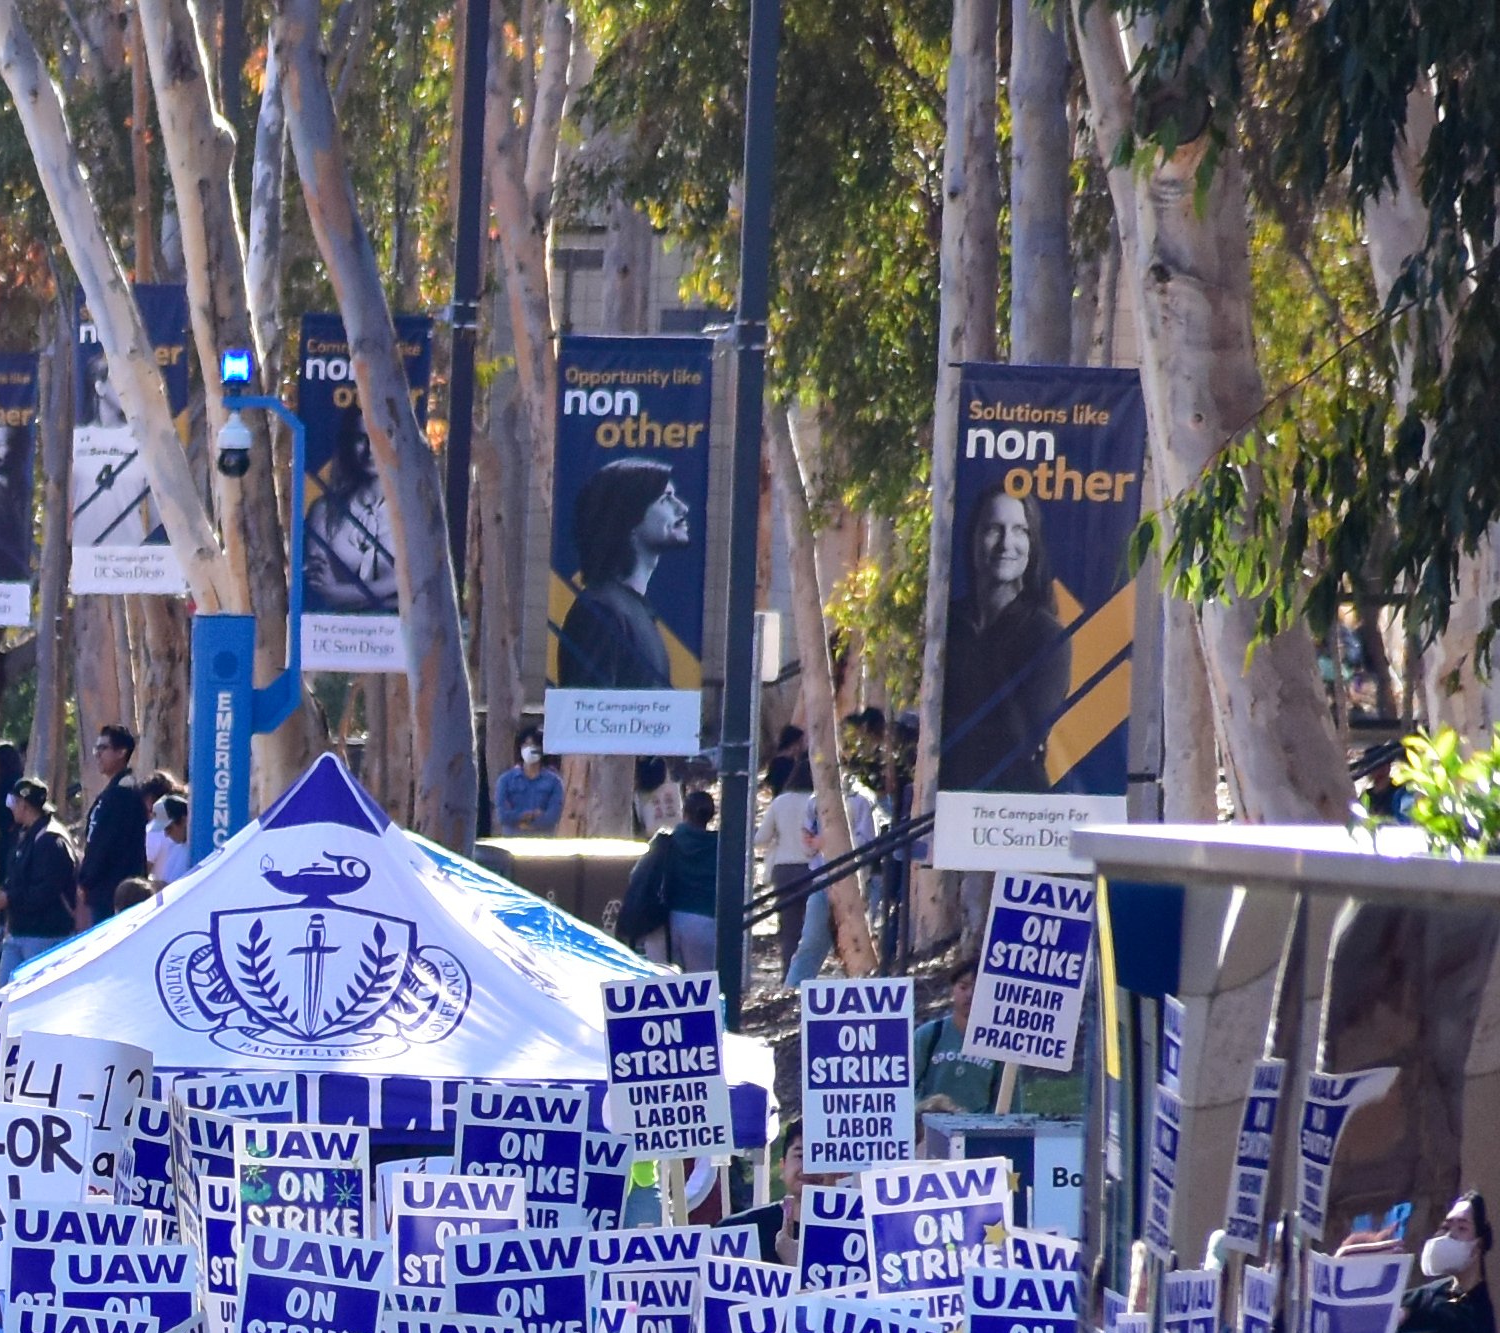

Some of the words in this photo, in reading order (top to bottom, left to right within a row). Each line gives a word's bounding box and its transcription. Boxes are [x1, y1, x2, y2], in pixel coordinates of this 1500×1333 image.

[565, 367, 668, 388] Opportunity
[672, 368, 701, 385] like
[564, 388, 638, 416] non
[969, 401, 1067, 425] Solutions
[1071, 405, 1110, 425] like
[596, 411, 703, 449] other
[966, 427, 1056, 460] non
[1004, 458, 1136, 501] other
[313, 624, 328, 633] The
[331, 625, 377, 638] Campaign
[313, 639, 332, 654] UC
[333, 640, 357, 655] San
[359, 640, 394, 656] Diego
[575, 701, 594, 711] The
[598, 701, 650, 713] Campaign
[652, 702, 670, 711] For
[575, 718, 597, 733] UC
[600, 718, 627, 733] San
[629, 719, 670, 737] Diego
[212, 691, 233, 846] EMERGENC
[972, 807, 996, 821] The
[1001, 807, 1061, 825] Campaign
[1065, 808, 1089, 821] For
[972, 828, 1002, 848] UC
[1005, 828, 1039, 848] San
[1041, 829, 1070, 848] Die
[1002, 876, 1095, 913] UAW
[1021, 914, 1062, 946] ON
[987, 940, 1082, 980] STRIKE
[170, 954, 196, 1019] NATIONAL
[421, 960, 460, 1040] CONFERENCE
[807, 985, 907, 1015] UAW
[993, 981, 1064, 1011] UNFAIR
[992, 1004, 1055, 1033] LABOR
[238, 1041, 386, 1060] PANHELLENIC
[837, 1023, 876, 1052] ON
[972, 1025, 1067, 1059] PRACTICE
[810, 1054, 906, 1084] STRIKE
[822, 1092, 896, 1114] UNFAIR
[826, 1116, 892, 1138] LABOR
[810, 1140, 909, 1162] PRACTICE
